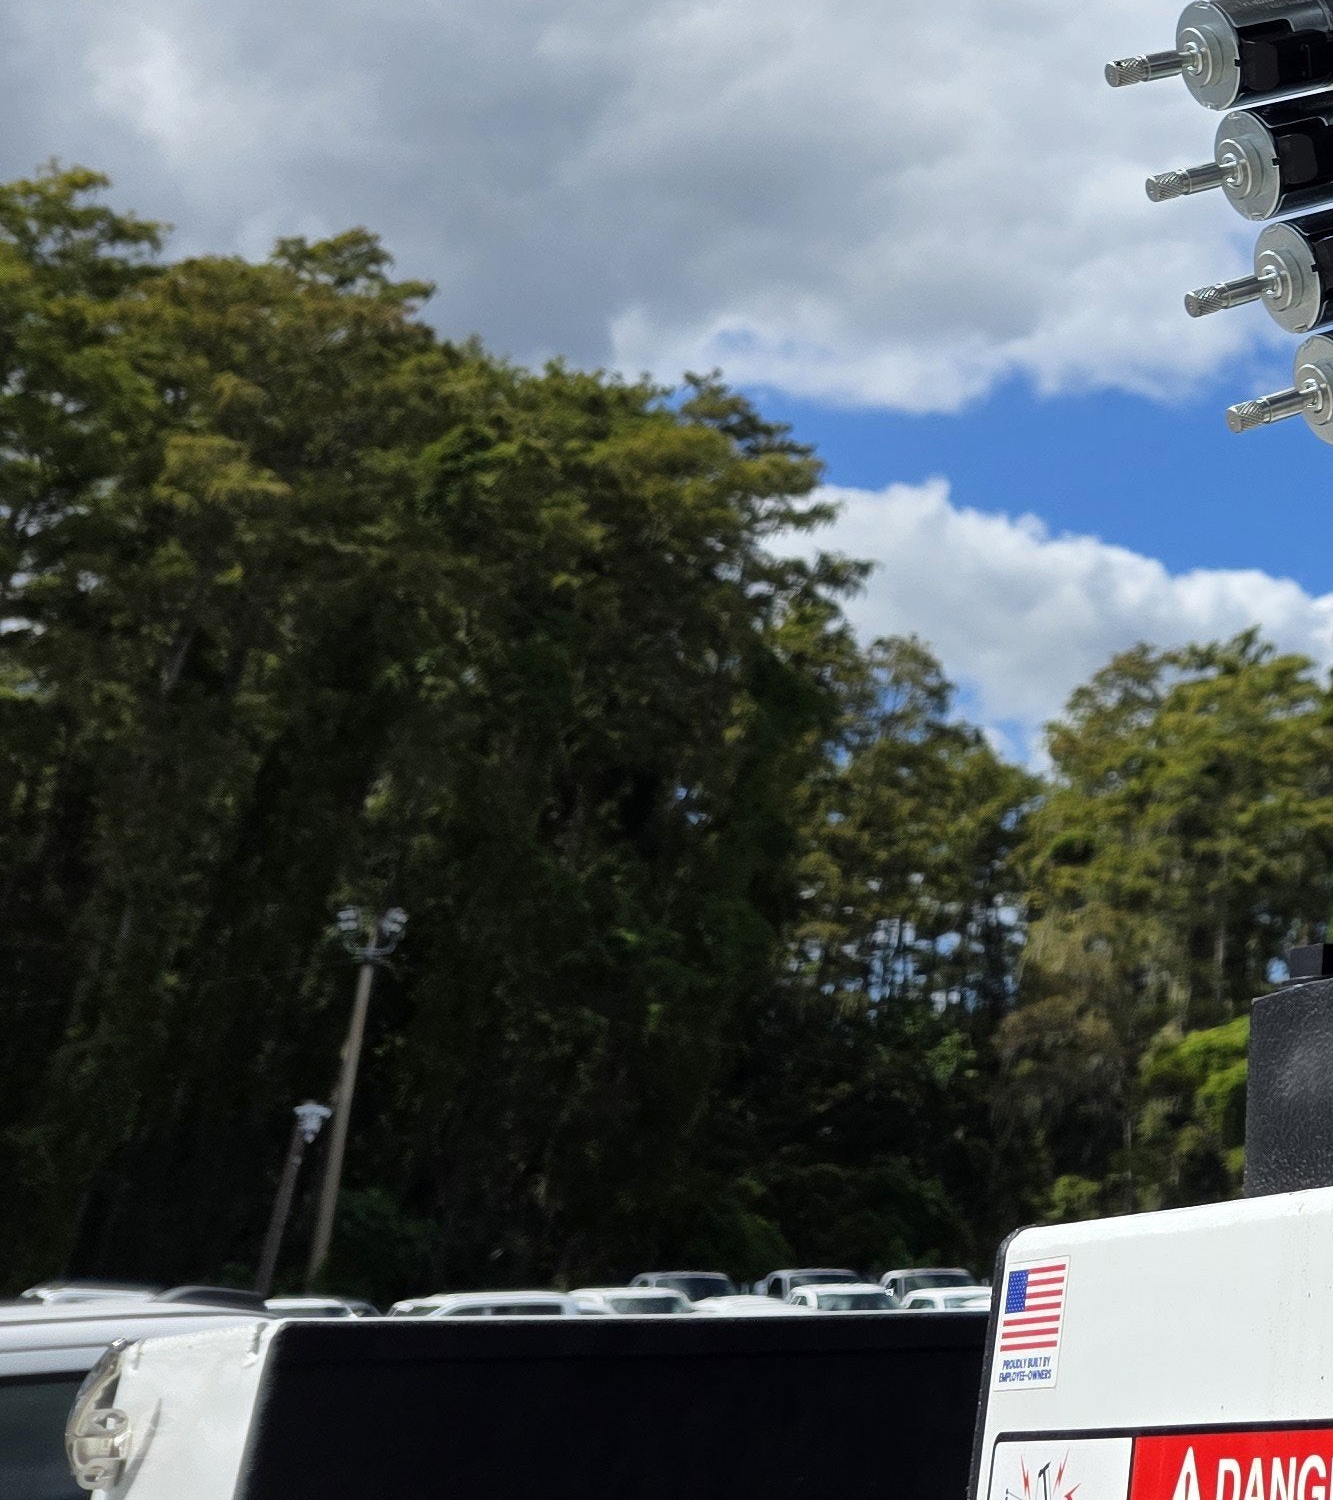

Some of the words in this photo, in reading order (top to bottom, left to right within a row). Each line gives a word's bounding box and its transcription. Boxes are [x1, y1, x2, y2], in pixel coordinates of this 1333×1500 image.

[1002, 1357, 1027, 1370] PROUDLY
[1027, 1357, 1042, 1369] BUILT
[1043, 1356, 1051, 1368] BY
[999, 1369, 1052, 1383] EMPLOYEE-OWNERS
